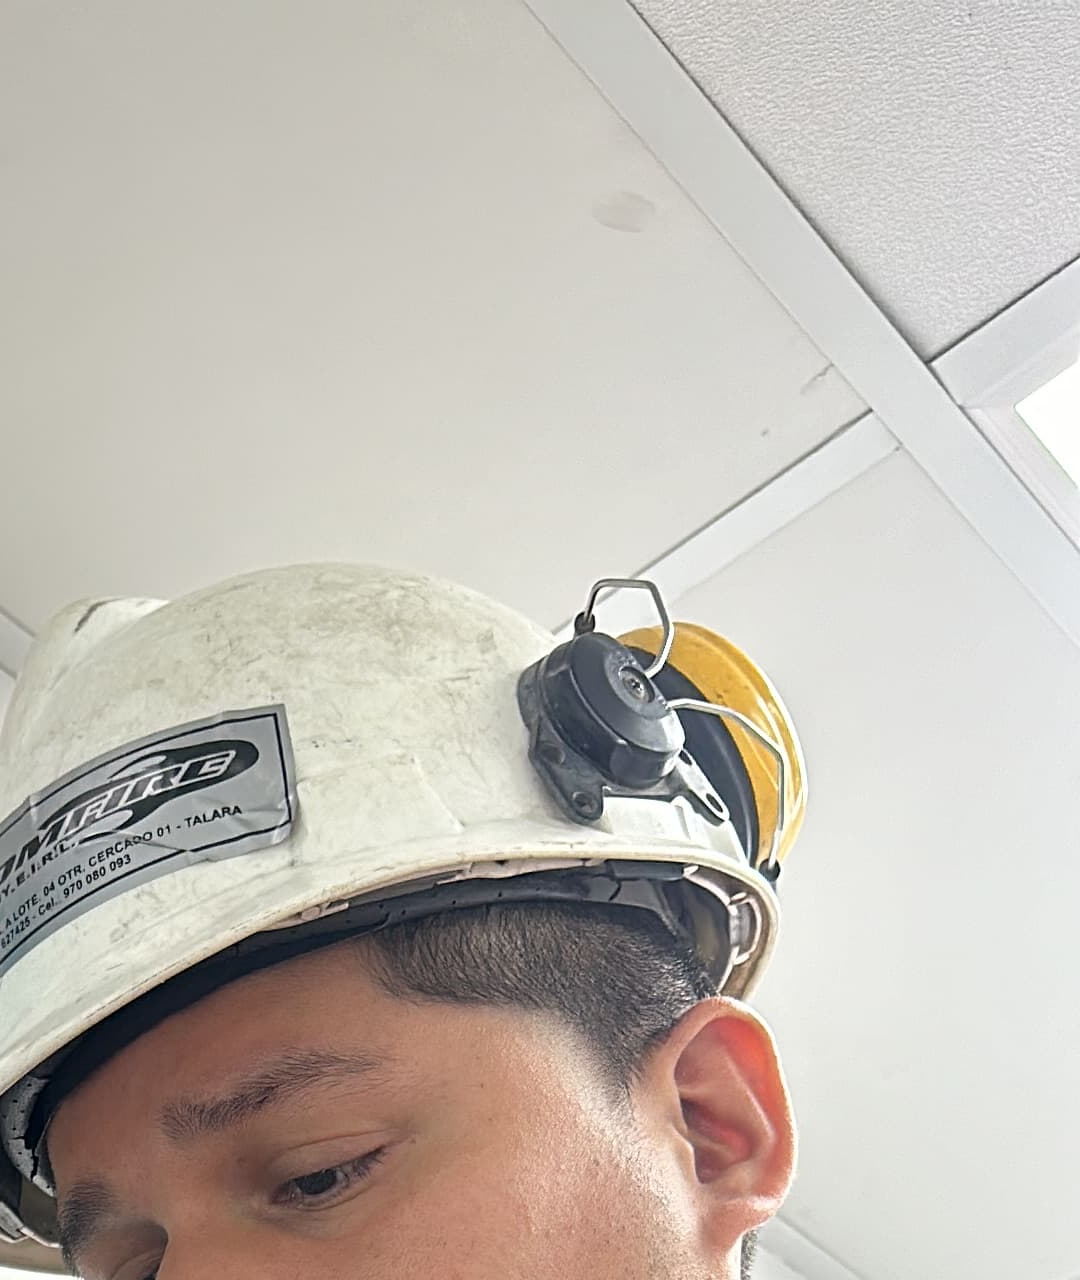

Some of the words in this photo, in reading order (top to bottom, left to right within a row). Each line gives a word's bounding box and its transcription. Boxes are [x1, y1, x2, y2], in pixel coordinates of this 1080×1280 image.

[43, 882, 56, 898] 04
[89, 831, 153, 868] CERCADO
[156, 824, 171, 838] 01
[184, 805, 243, 828] TALARA
[63, 880, 83, 899] 970
[86, 868, 107, 885] 080
[110, 856, 132, 874] 093
